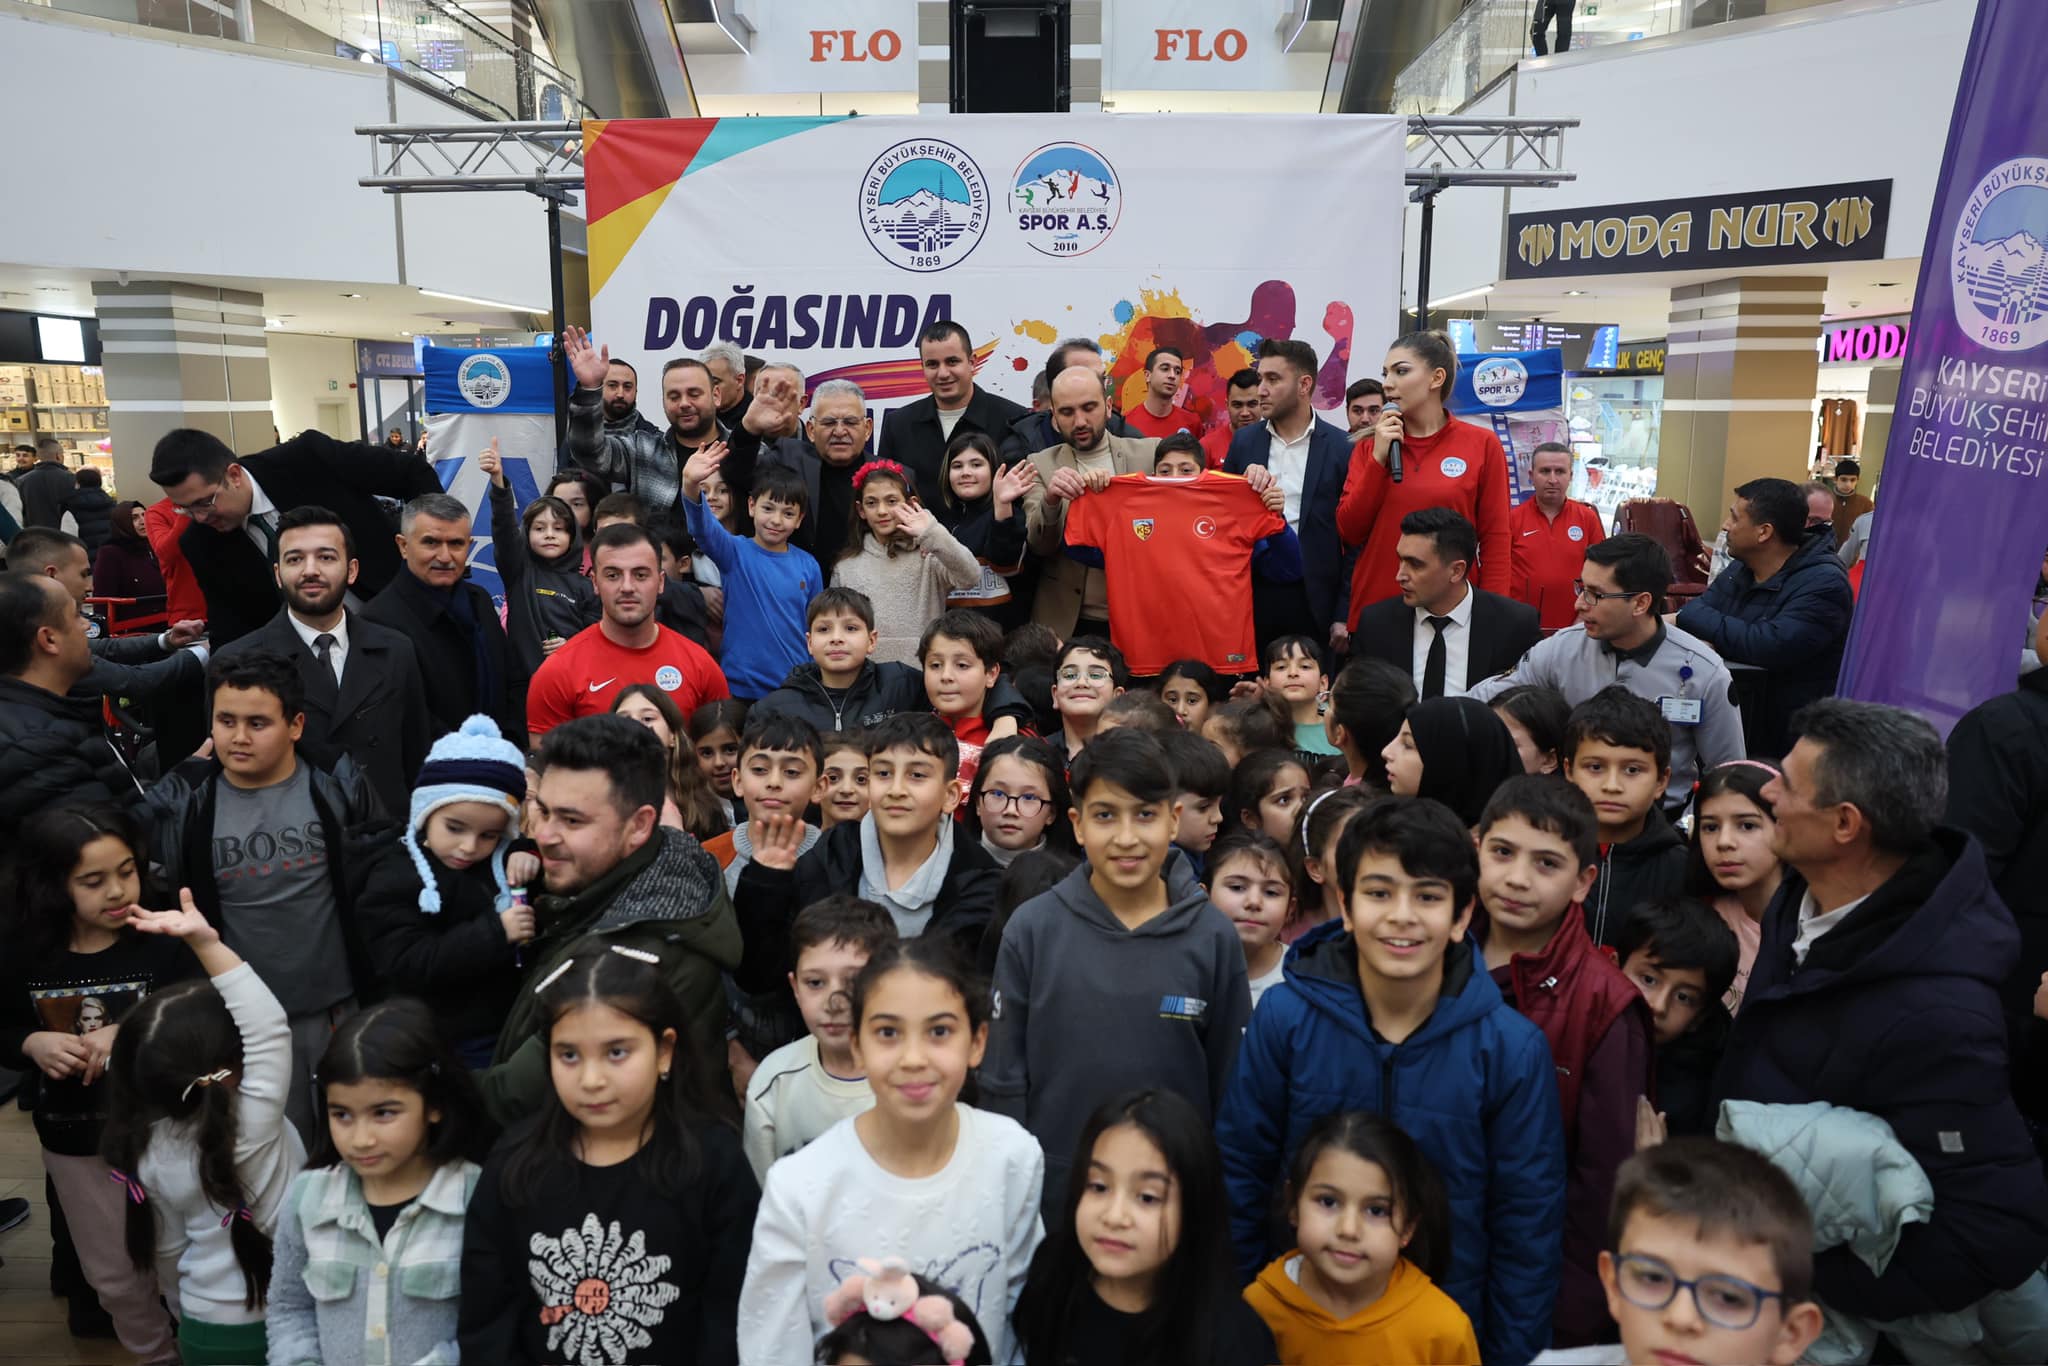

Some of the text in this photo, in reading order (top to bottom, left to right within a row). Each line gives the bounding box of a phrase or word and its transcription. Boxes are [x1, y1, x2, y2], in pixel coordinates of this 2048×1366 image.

[809, 29, 902, 62] FLO
[1153, 28, 1248, 62] FLO
[866, 145, 985, 234] KAYSERİ BÜYÜKŞEHİR BELEDİYESİ
[1019, 214, 1111, 234] SPOR A.Ş.
[1559, 210, 1693, 260] MODA
[1708, 200, 1819, 251] NUR
[1957, 163, 2048, 284] KAYSERİ BÜYÜKŞ
[909, 255, 941, 267] 1869
[1053, 242, 1078, 252] 2010
[644, 284, 952, 350] DOĞASINDA
[1981, 326, 2021, 344] 1869
[1636, 348, 1665, 372] GENÇ
[1829, 323, 1910, 362] MOD
[1479, 385, 1502, 395] SPOR
[1937, 355, 2048, 403] KAYSERİ
[1909, 427, 2045, 478] BELEDİYESİ
[212, 821, 326, 868] BOSS
